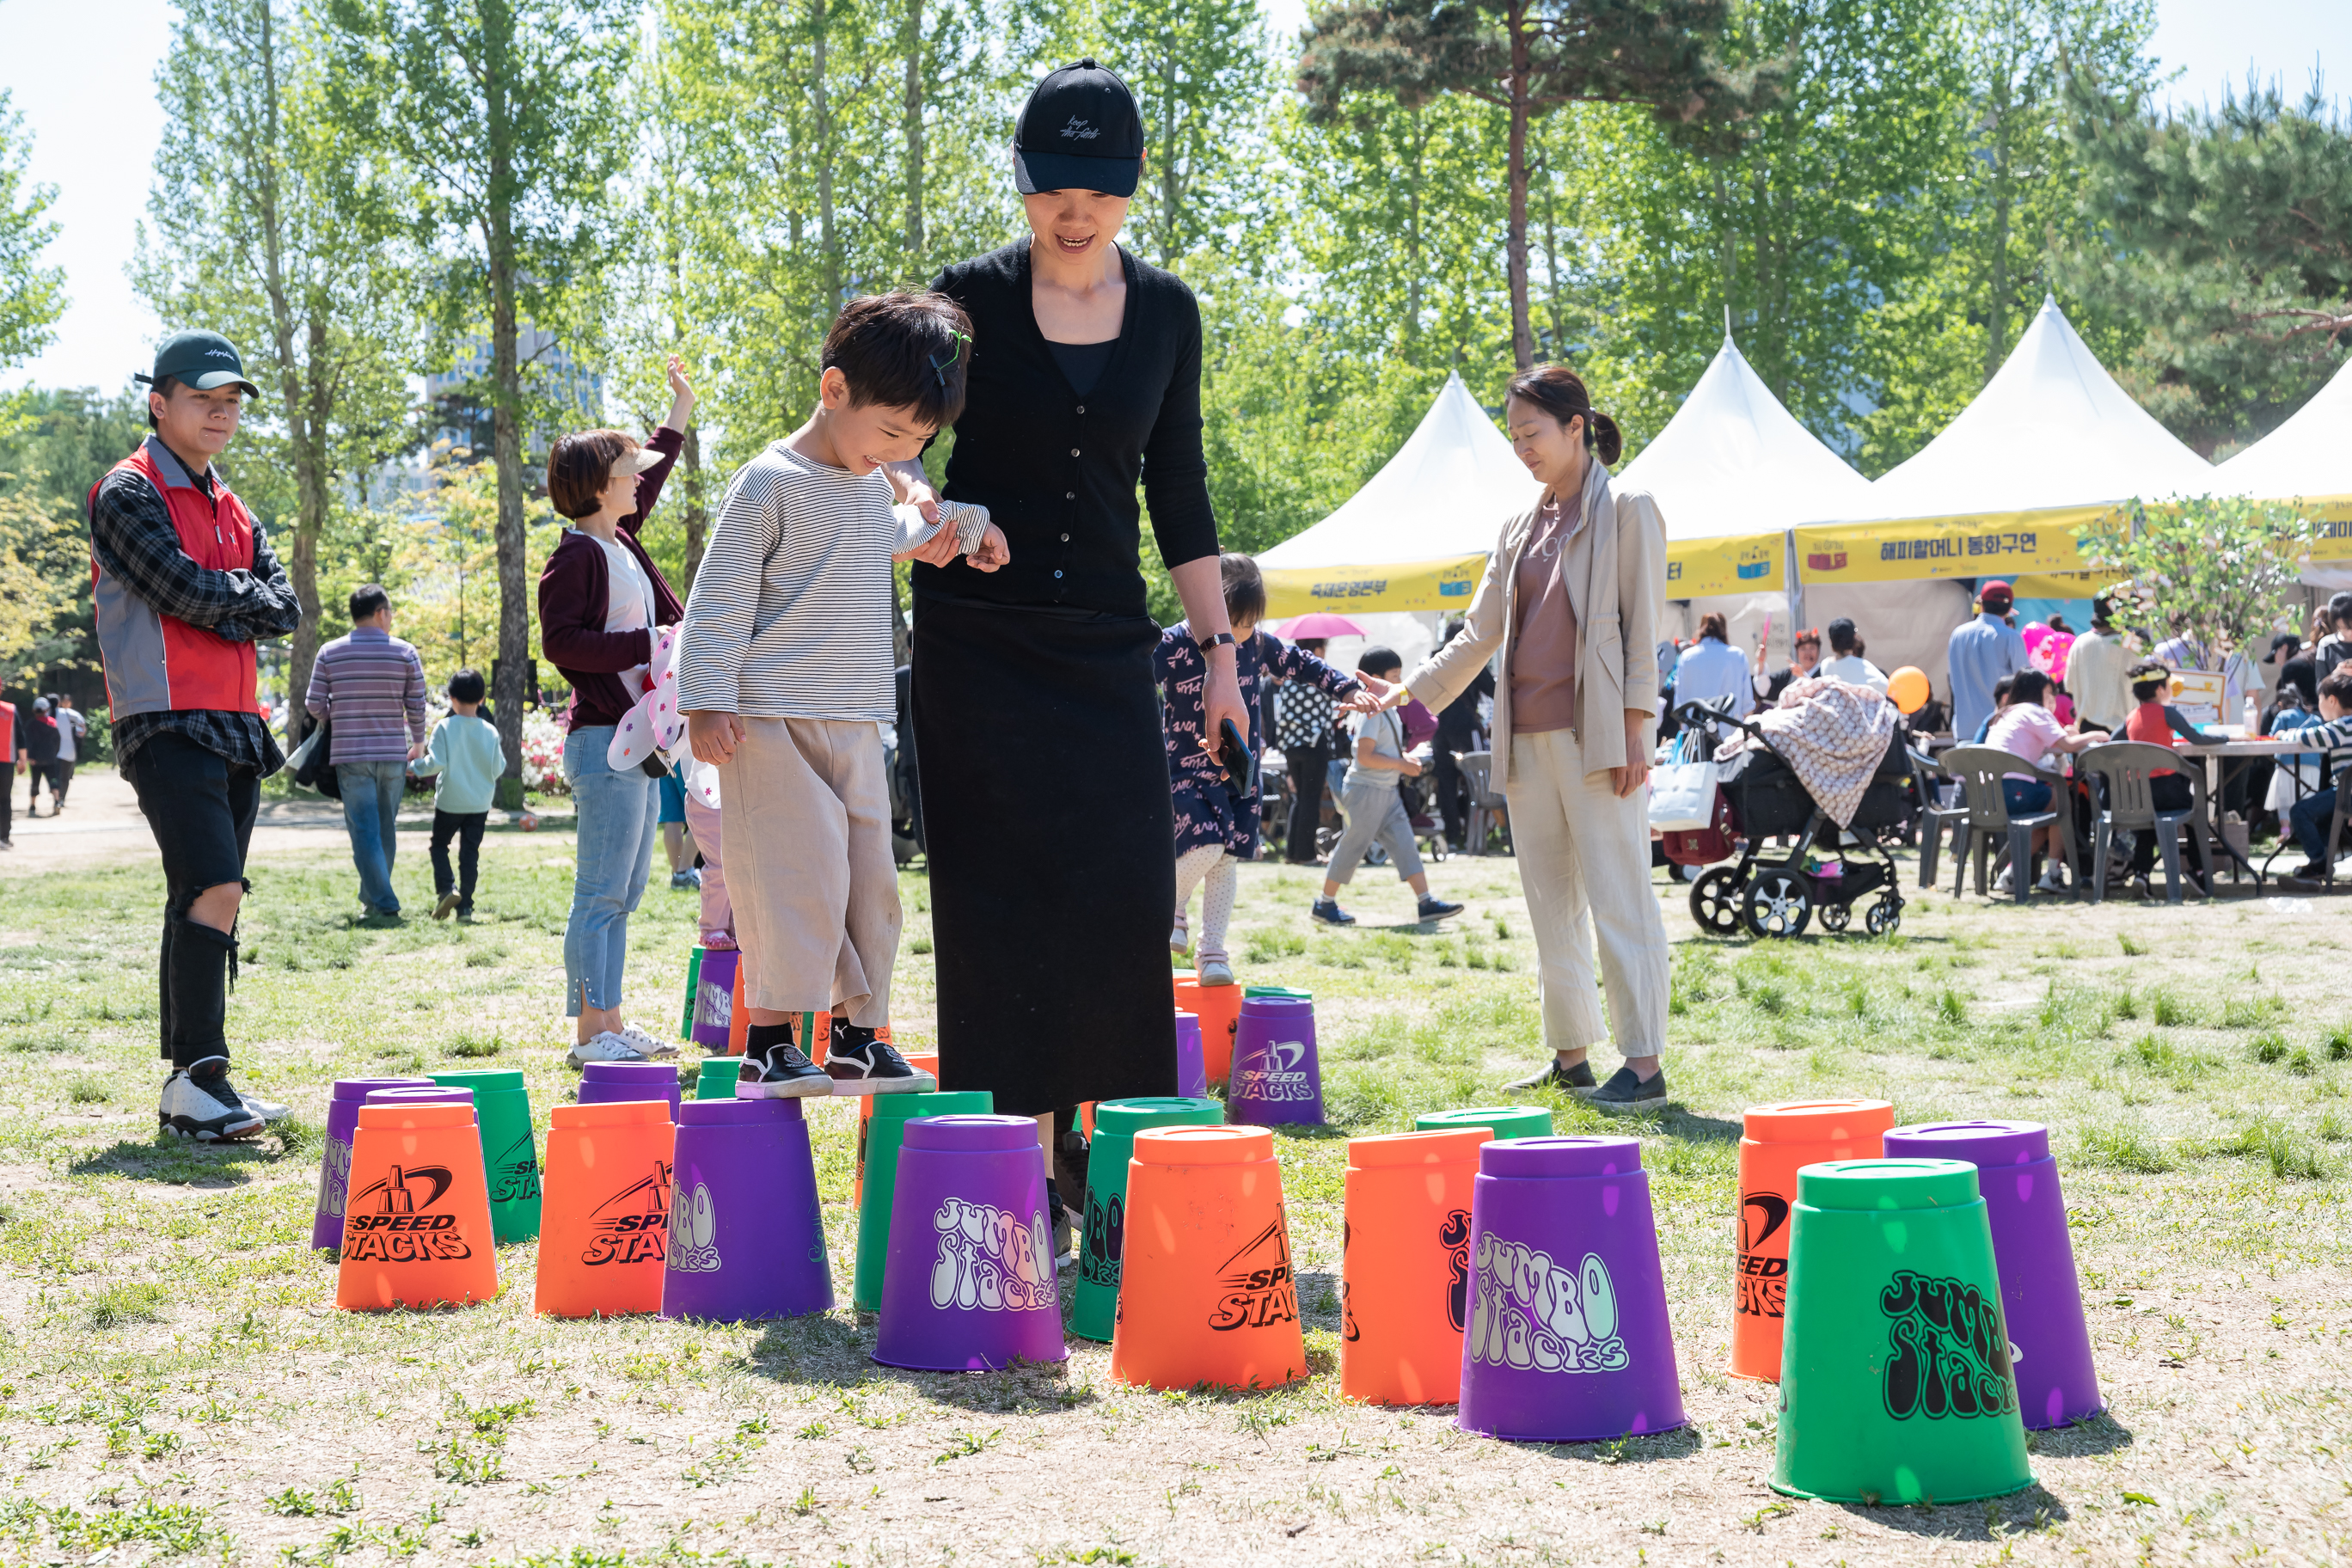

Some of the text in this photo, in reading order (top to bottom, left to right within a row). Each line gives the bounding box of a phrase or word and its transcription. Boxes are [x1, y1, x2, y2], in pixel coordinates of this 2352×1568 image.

[1880, 532, 2037, 561] 해피할머니 동화구연
[1242, 1070, 1307, 1082] SPEED
[1231, 1080, 1314, 1101] STACKS
[354, 1214, 456, 1231] SPEED
[341, 1230, 472, 1262] STACKS
